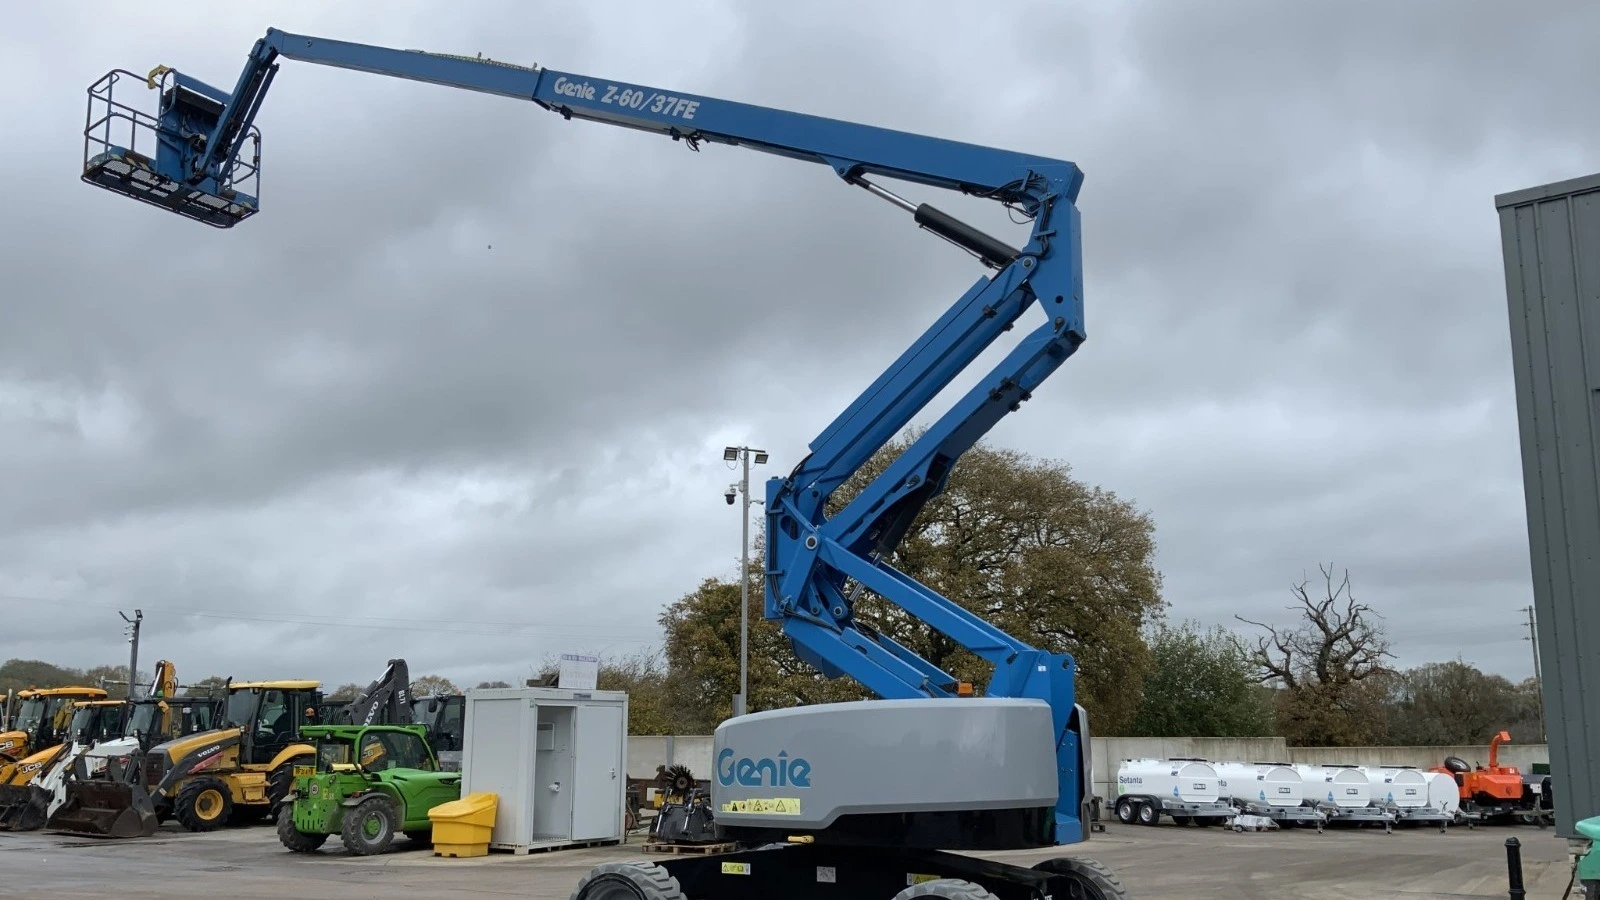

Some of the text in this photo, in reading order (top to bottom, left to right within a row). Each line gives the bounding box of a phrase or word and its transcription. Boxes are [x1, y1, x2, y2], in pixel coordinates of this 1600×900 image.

[554, 76, 700, 120] Genie Z-60/37FE
[398, 690, 406, 704] BL71
[363, 701, 379, 727] LVO
[0, 741, 14, 750] CB
[197, 745, 220, 758] VOLVO
[22, 762, 42, 774] JCB
[717, 748, 811, 788] Genie
[1119, 776, 1143, 784] Setanta
